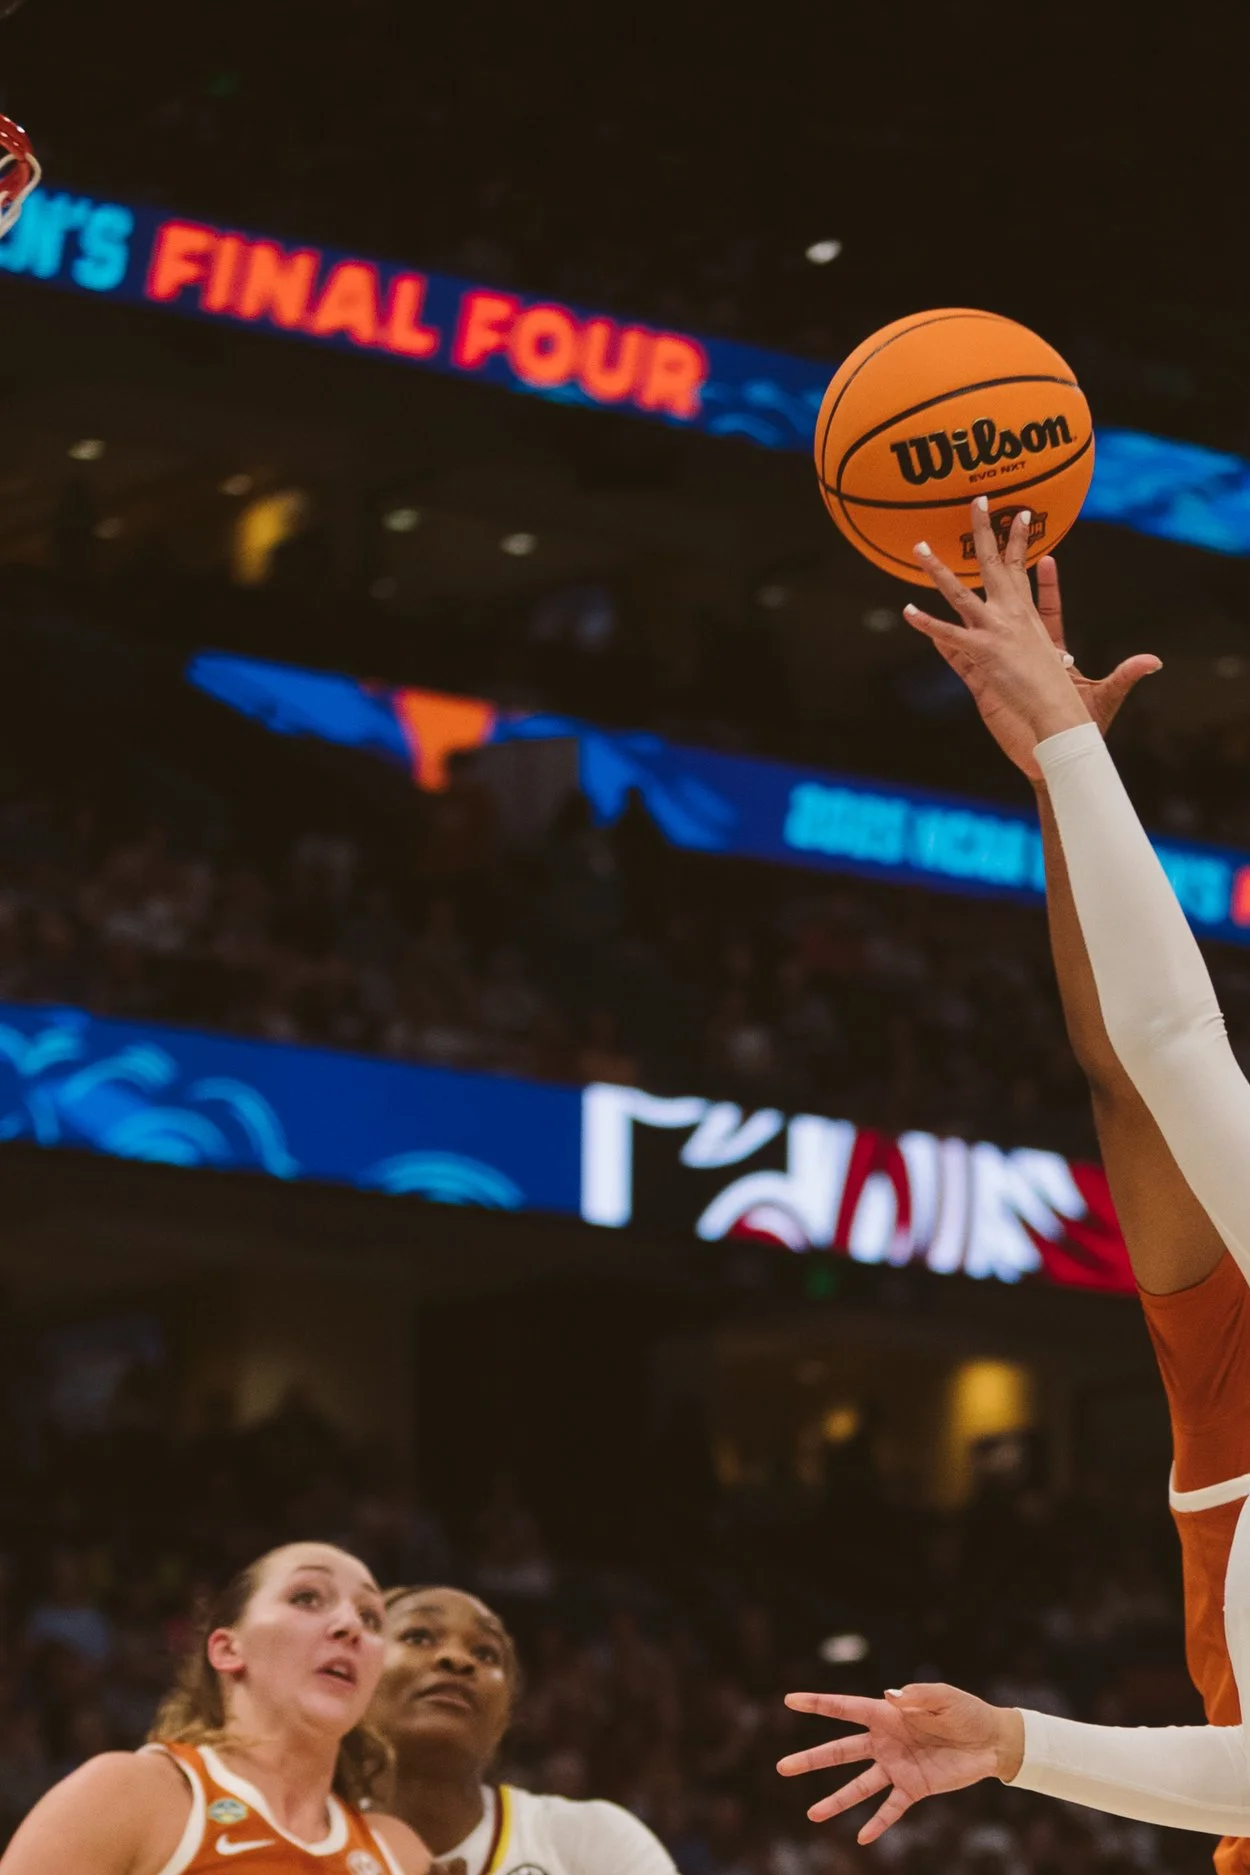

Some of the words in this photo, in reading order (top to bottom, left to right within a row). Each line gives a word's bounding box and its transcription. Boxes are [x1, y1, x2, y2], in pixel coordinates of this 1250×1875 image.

[146, 218, 441, 358] FINAL
[451, 286, 710, 420] FOUR
[890, 413, 1073, 486] Wilson
[969, 469, 997, 484] EVO
[1000, 460, 1027, 475] NXT
